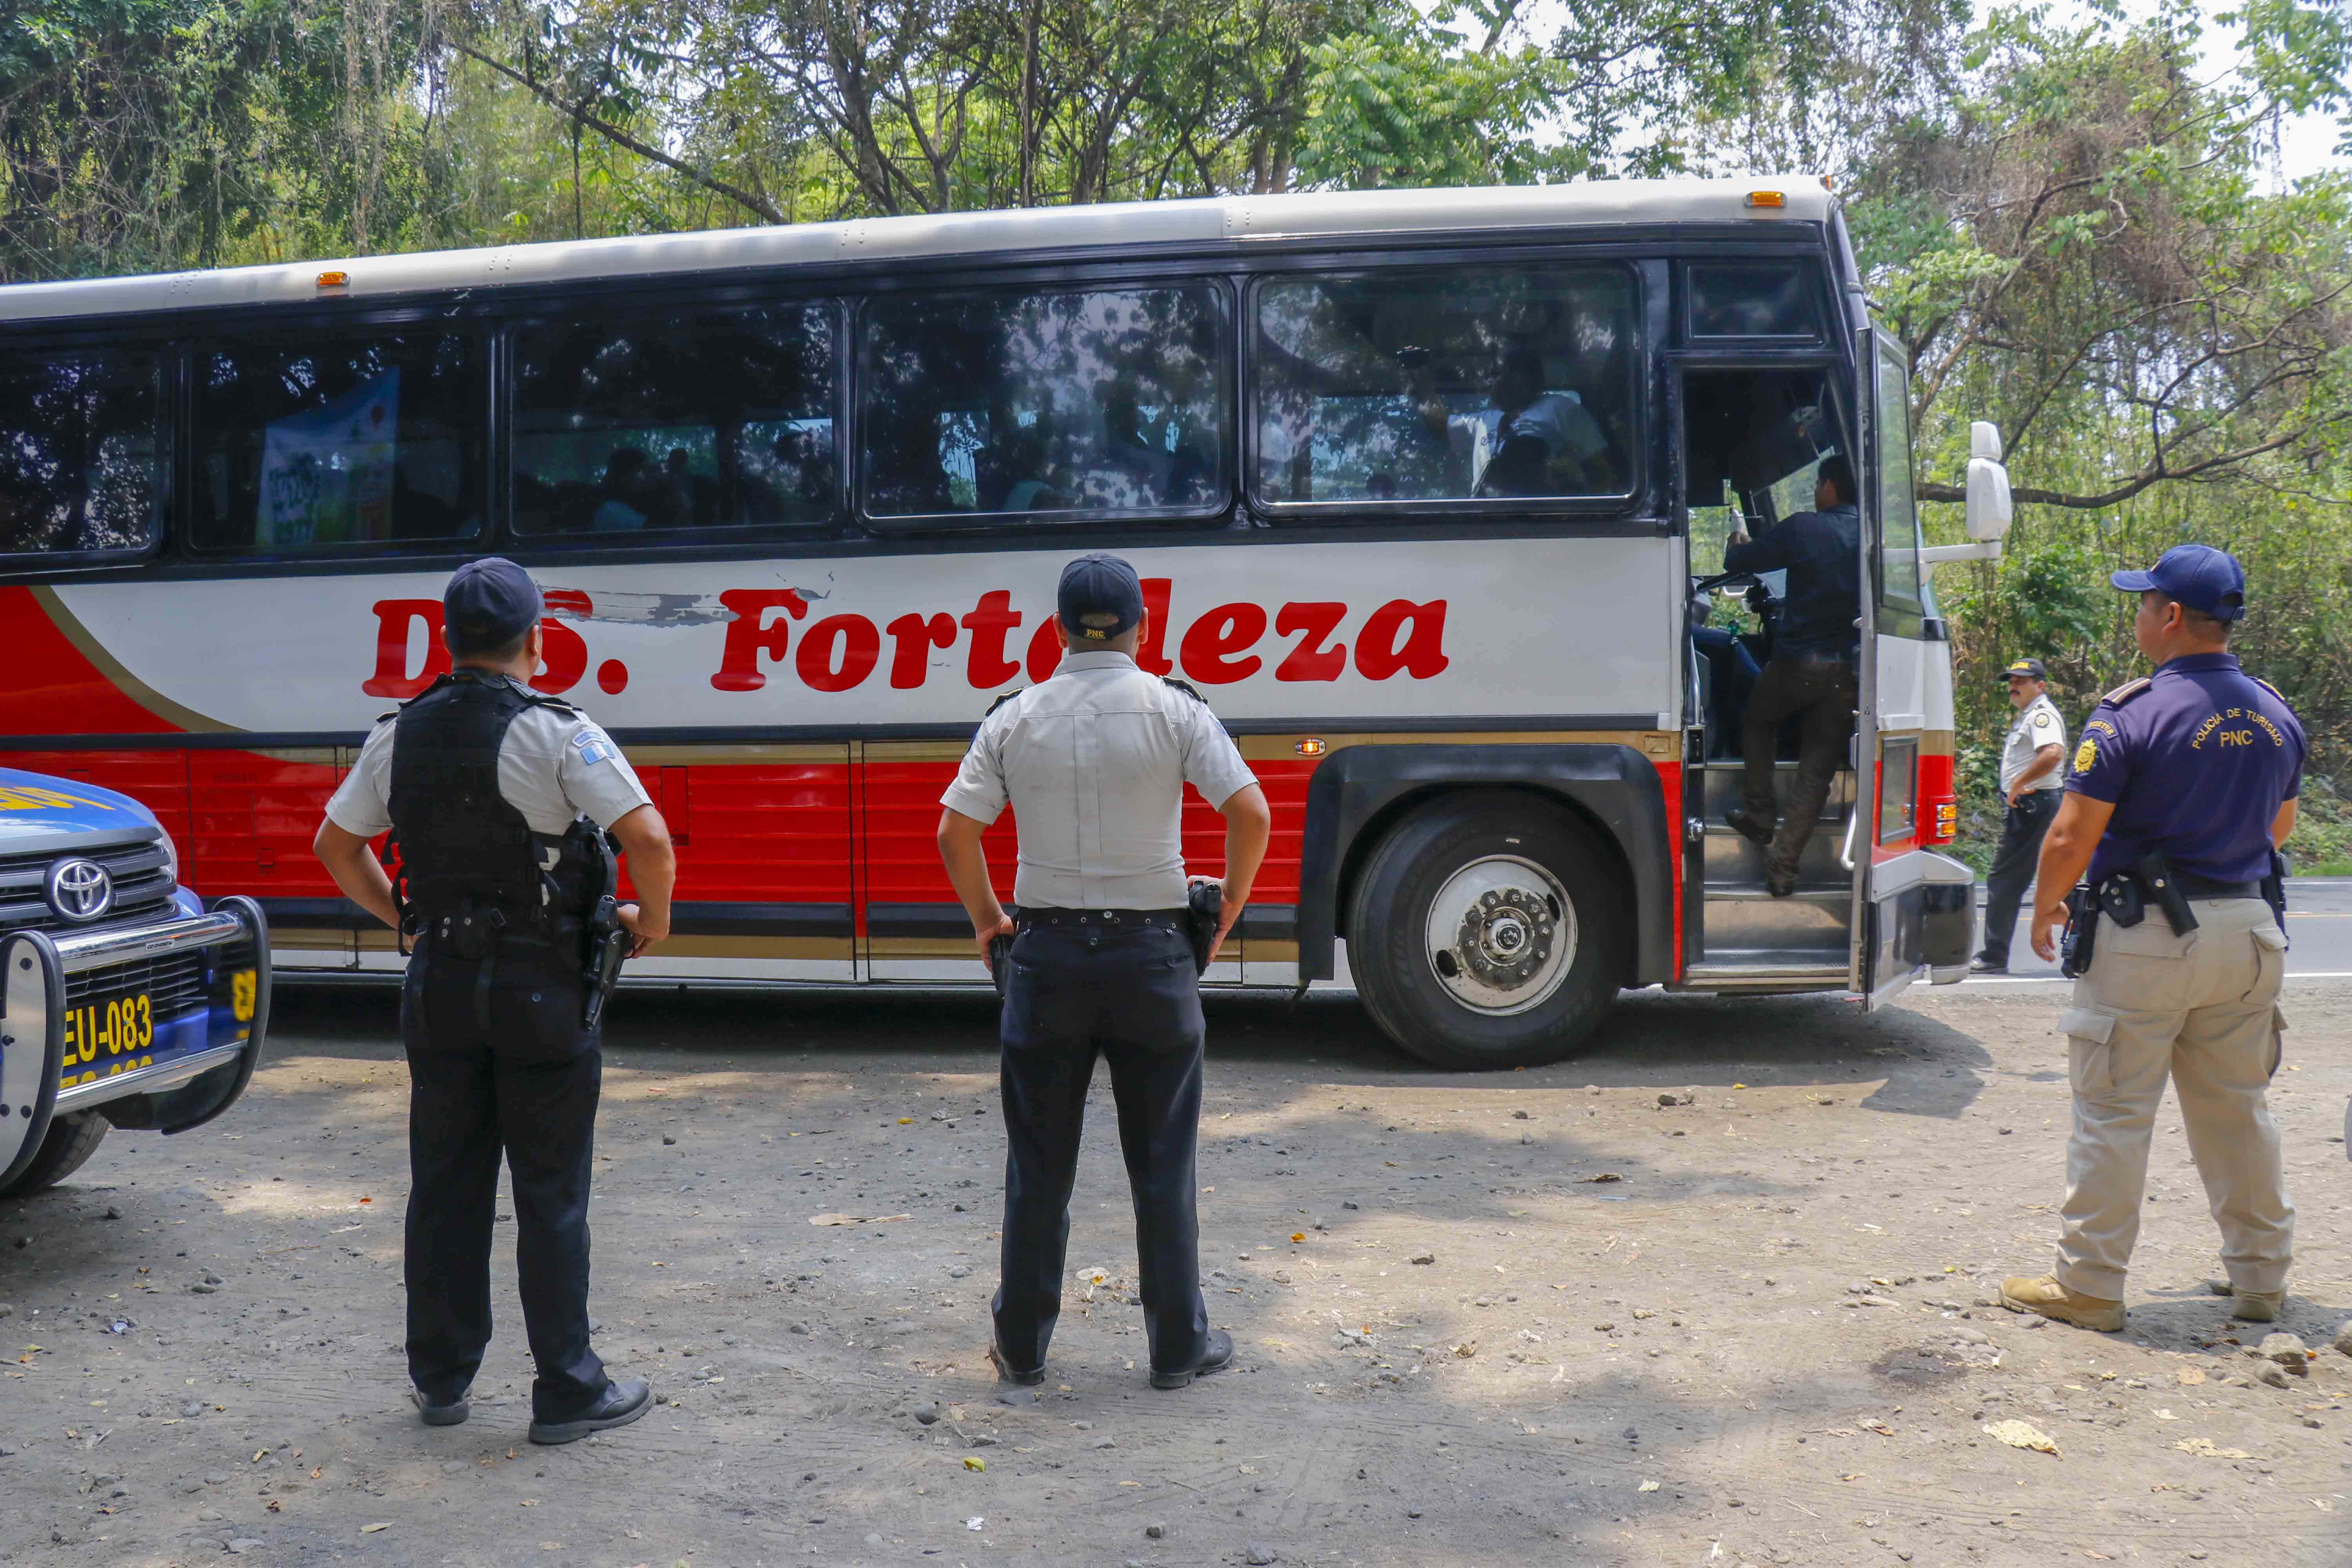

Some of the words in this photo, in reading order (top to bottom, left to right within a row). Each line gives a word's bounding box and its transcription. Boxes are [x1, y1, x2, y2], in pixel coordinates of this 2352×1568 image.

[1087, 629, 1104, 637] PNC
[2192, 713, 2225, 749] POLICIA
[2226, 708, 2241, 718] DE
[2246, 710, 2283, 747] TURISMO
[2220, 730, 2254, 747] PNC
